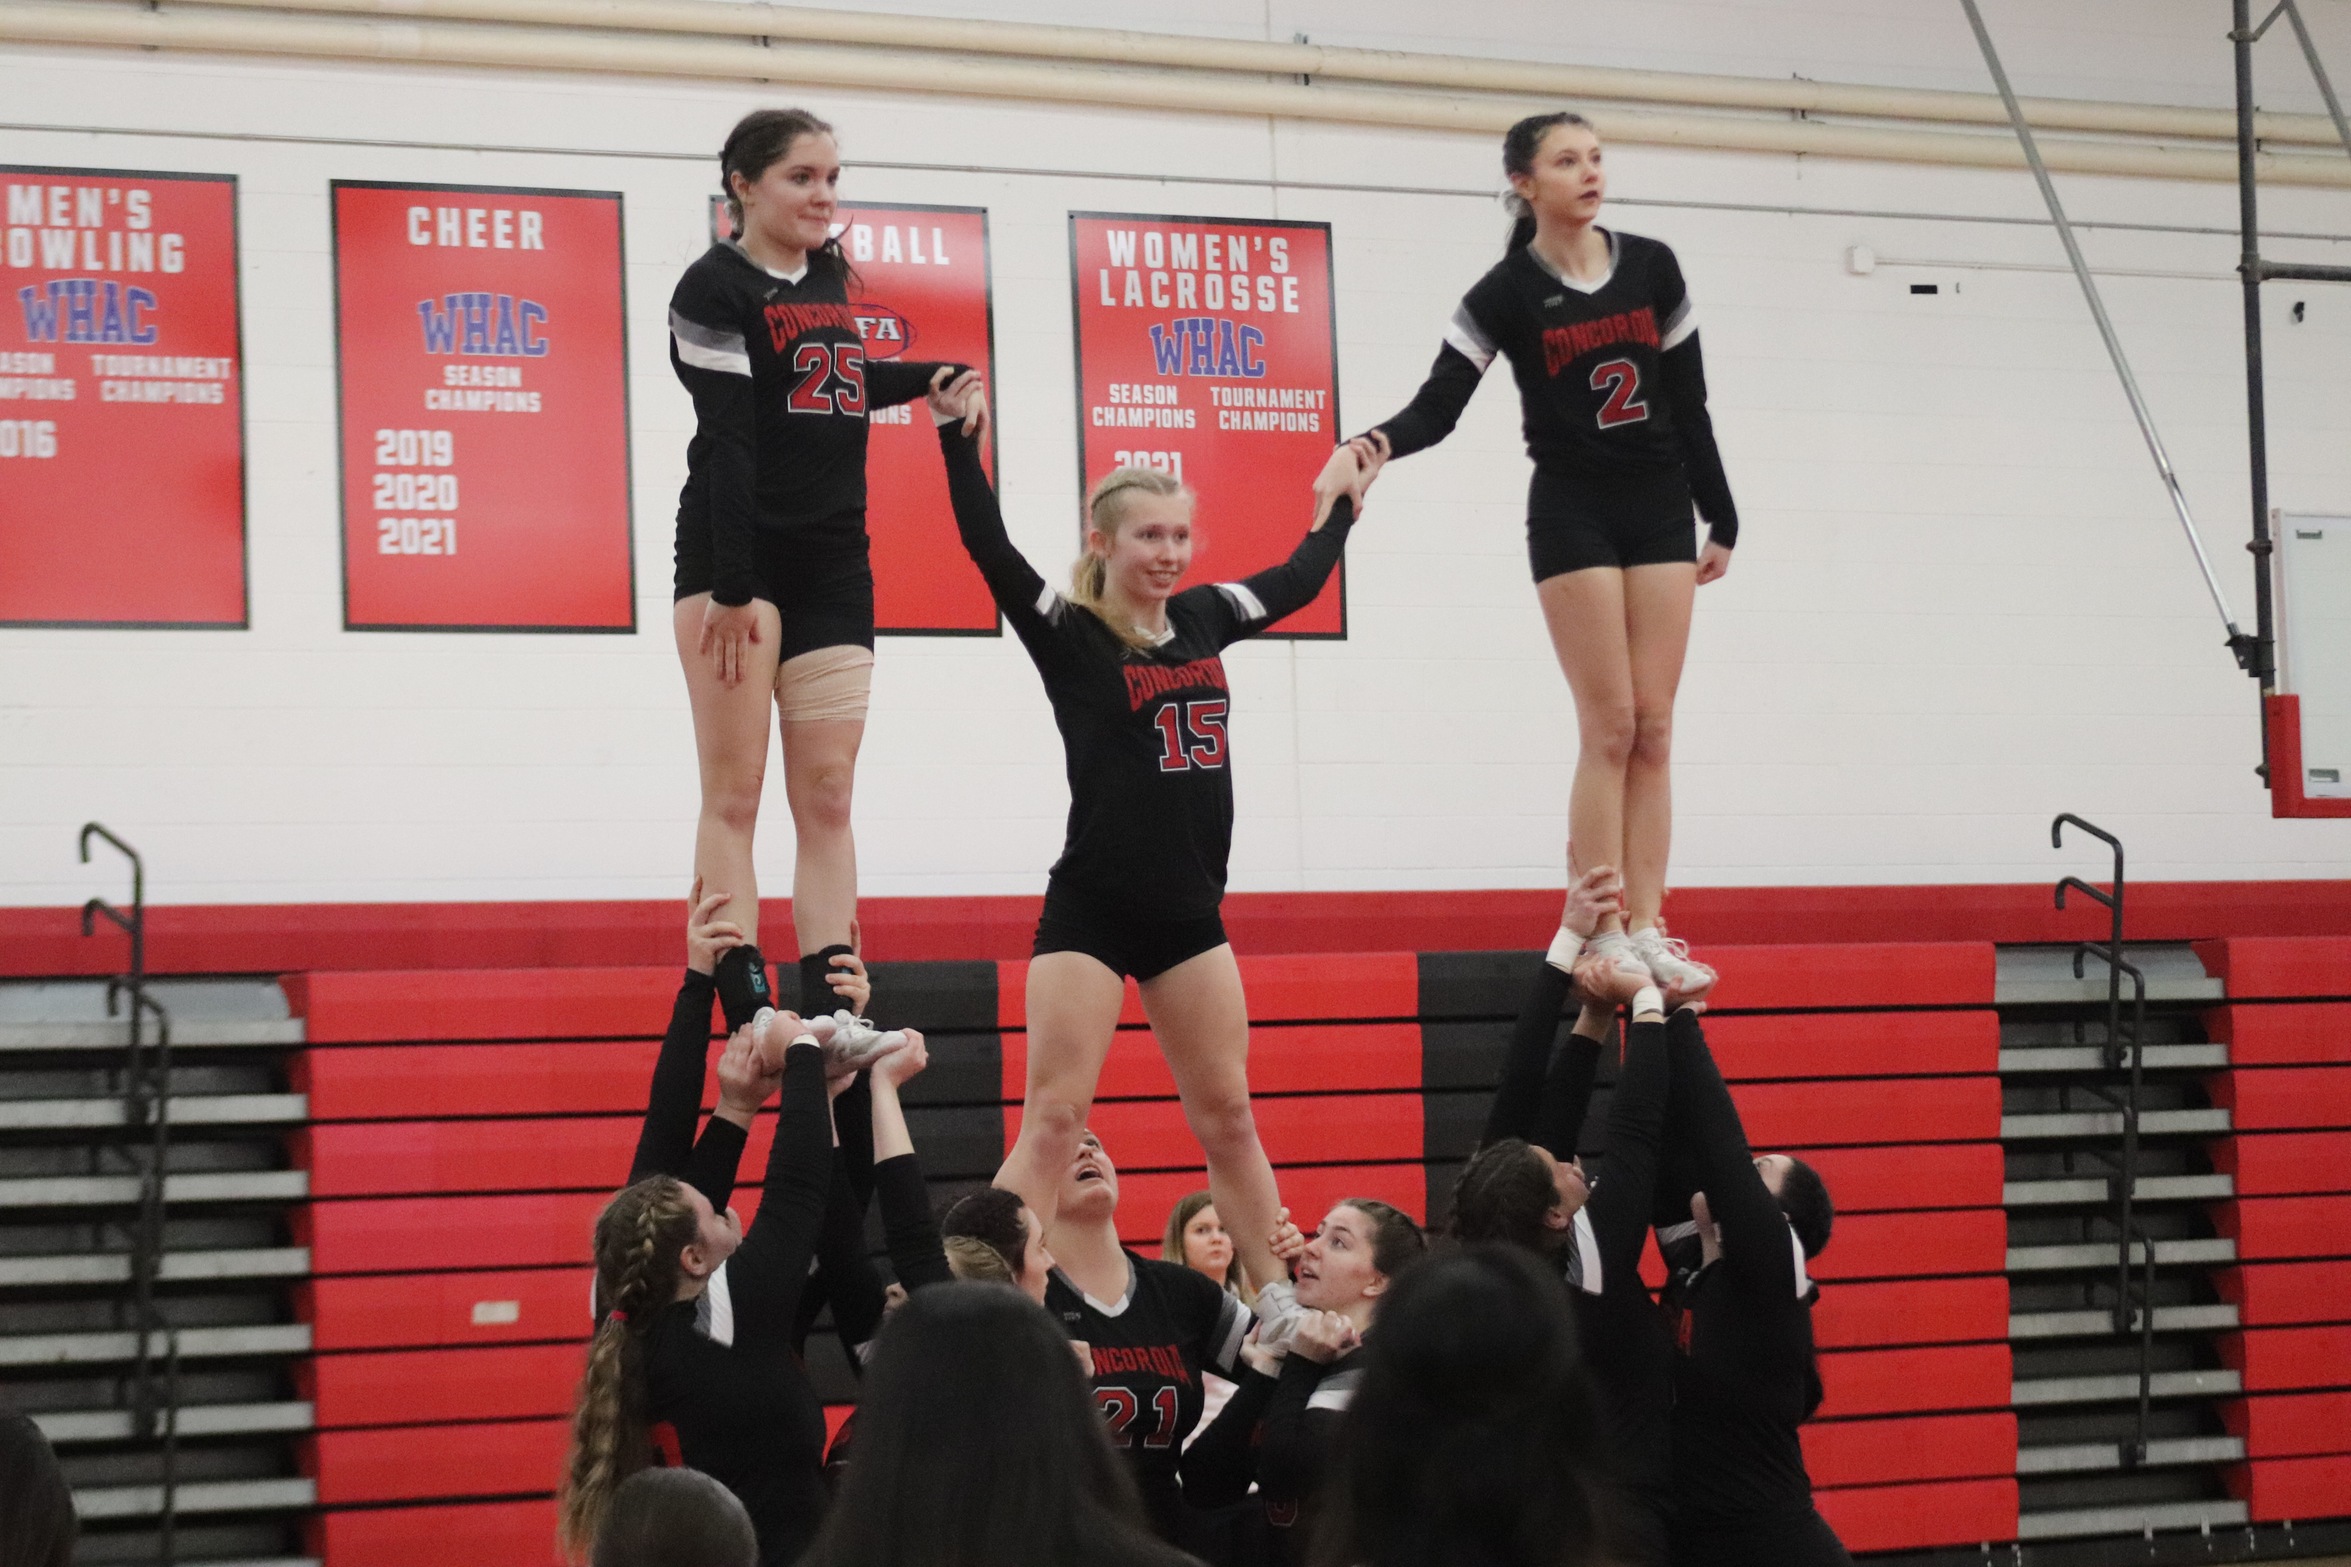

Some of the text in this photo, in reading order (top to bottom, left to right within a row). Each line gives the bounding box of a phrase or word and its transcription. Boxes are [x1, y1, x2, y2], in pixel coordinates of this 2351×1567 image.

[7, 185, 152, 229] MEN'S
[408, 206, 545, 250] CHEER
[0, 228, 186, 273] OWLING
[1107, 229, 1289, 274] WOMEN'S
[18, 277, 158, 345] WHAC
[1099, 269, 1299, 313] LACROSSE
[417, 292, 550, 357] WHAC
[91, 354, 232, 379] TOURNAMENT
[1149, 317, 1266, 378] WHAC
[102, 380, 224, 404] CHAMPIONS
[444, 364, 522, 388] SEASON
[788, 342, 865, 417] 25
[1109, 383, 1178, 405] SEASON
[1589, 358, 1648, 429] 2
[425, 388, 542, 412] CHAMPIONS
[1092, 406, 1196, 429] CHAMPIONS
[1210, 387, 1326, 410] TOURNAMENT
[1218, 410, 1320, 433] CHAMPIONS
[375, 428, 453, 466] 2019
[373, 473, 459, 511] 2020
[377, 517, 457, 555] 2021
[1155, 699, 1227, 772] 15
[1091, 1343, 1193, 1388] NCORDIA
[1092, 1386, 1178, 1448] 21
